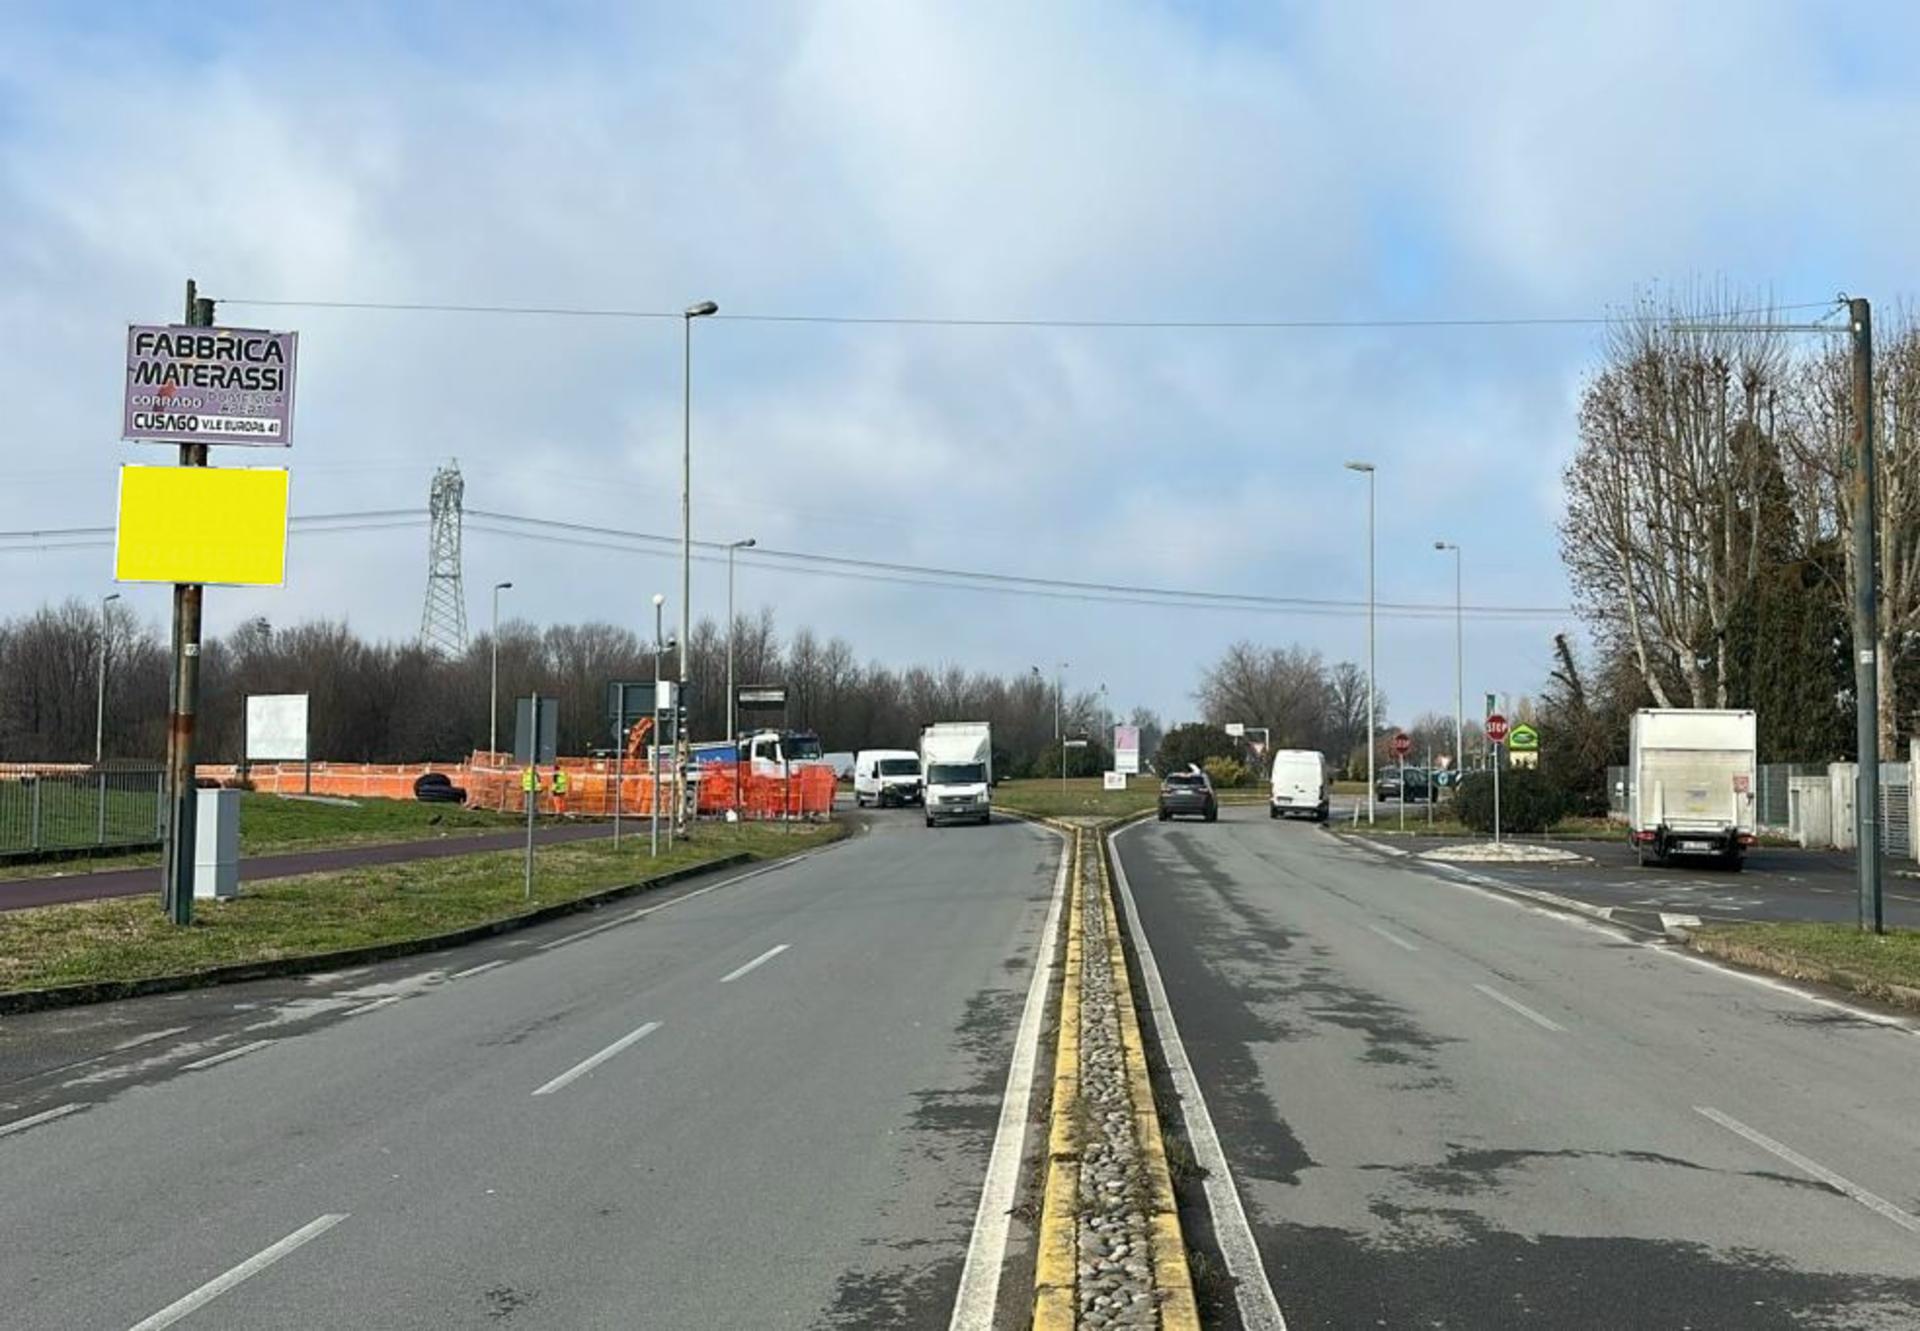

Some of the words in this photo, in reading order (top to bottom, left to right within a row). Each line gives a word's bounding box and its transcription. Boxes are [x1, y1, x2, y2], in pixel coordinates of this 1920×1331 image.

[135, 333, 284, 363] FABBRICA
[134, 361, 284, 392] MATERASSI
[132, 394, 203, 409] CORRADO
[134, 413, 199, 431] CUSAGO
[224, 420, 266, 433] EUROPA
[1487, 722, 1508, 733] STOP
